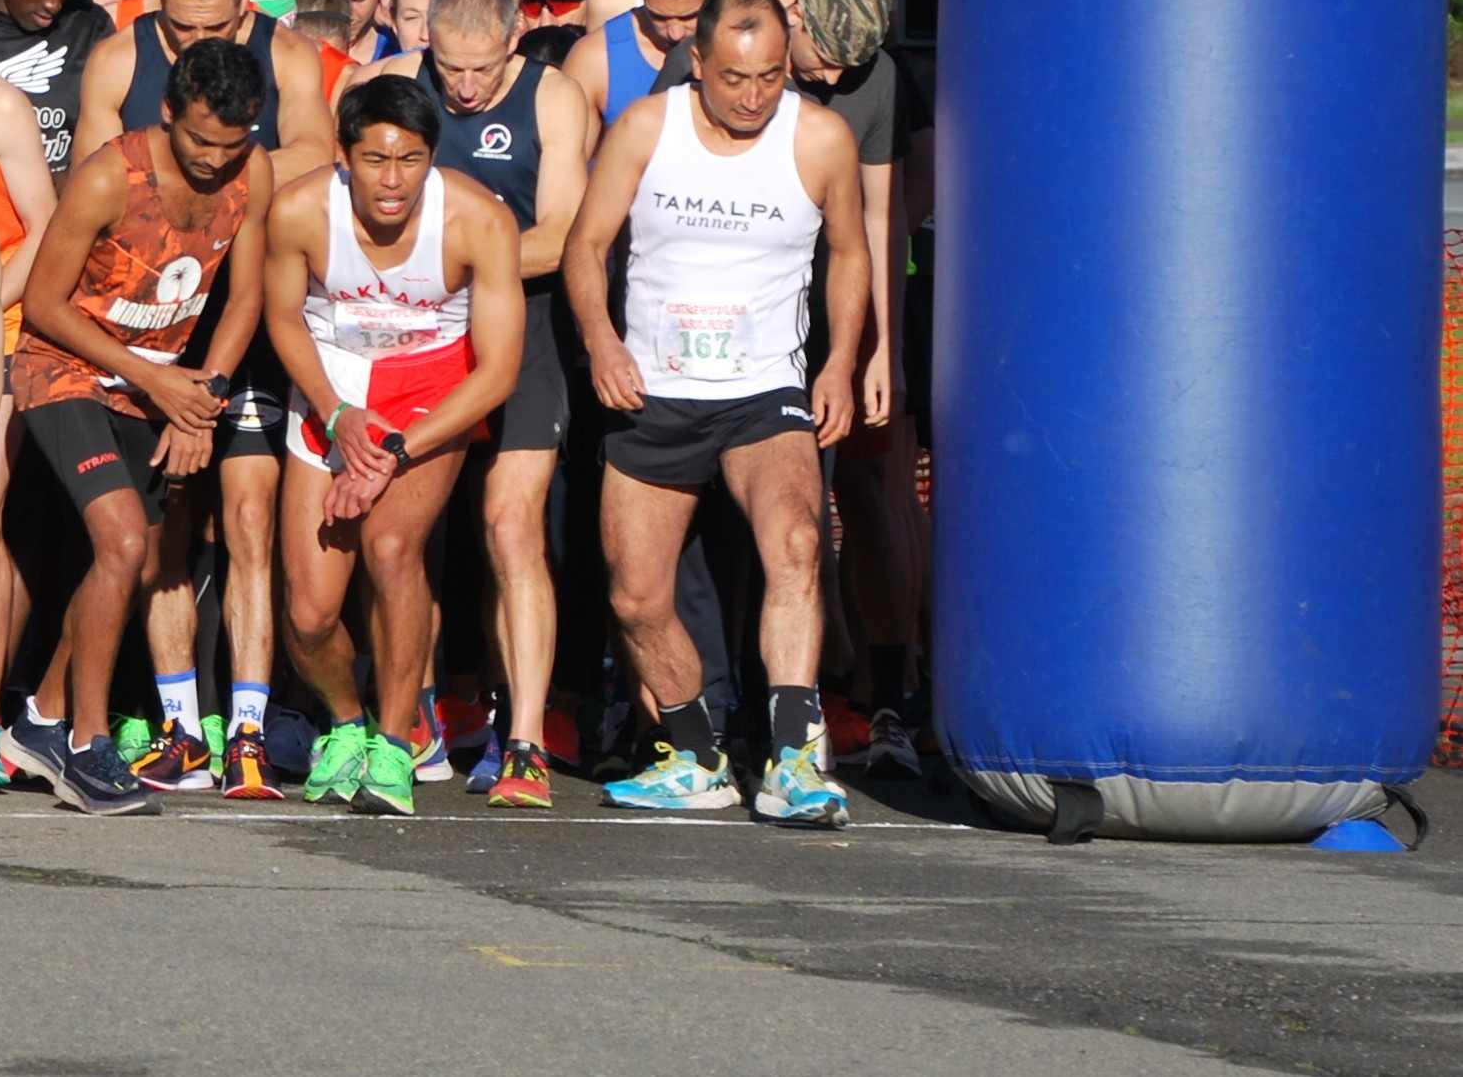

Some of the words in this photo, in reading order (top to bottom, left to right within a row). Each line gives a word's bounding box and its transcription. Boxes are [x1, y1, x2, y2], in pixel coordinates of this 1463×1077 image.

[653, 192, 785, 222] TAMALPA
[676, 214, 751, 232] runners
[679, 331, 731, 360] 167
